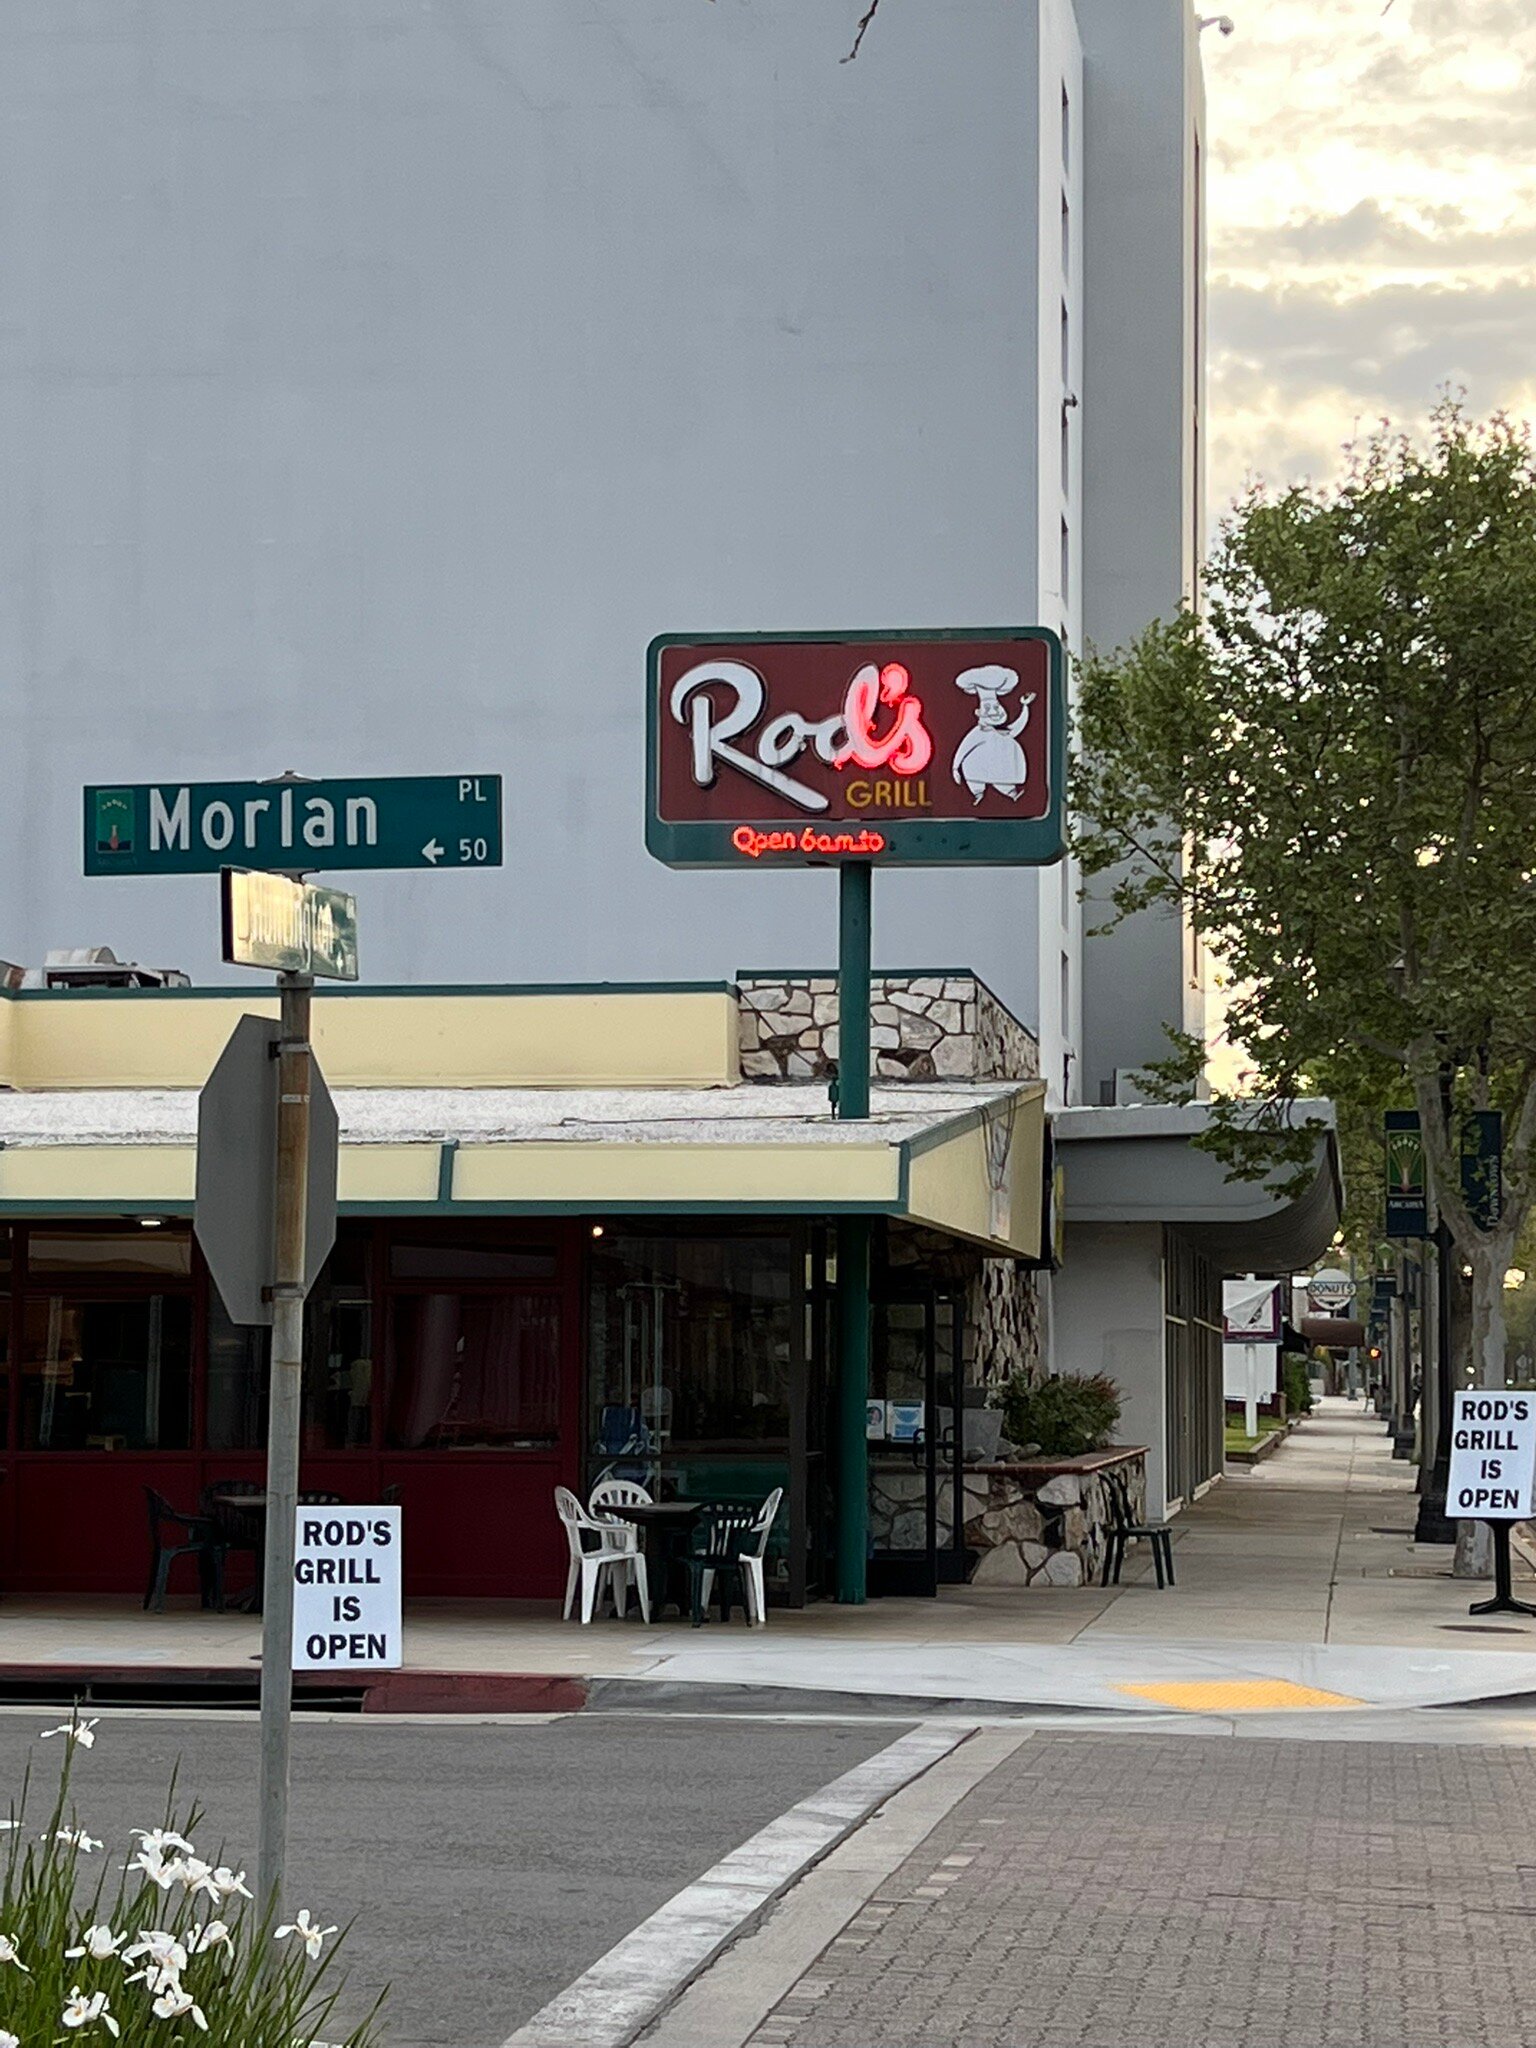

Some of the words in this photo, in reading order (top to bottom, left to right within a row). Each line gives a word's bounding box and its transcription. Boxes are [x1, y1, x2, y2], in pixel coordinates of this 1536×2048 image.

[671, 659, 933, 812] Rod's
[459, 779, 488, 802] PL
[846, 780, 932, 808] GRILL
[149, 787, 378, 851] Morlan
[459, 838, 488, 861] 50
[733, 825, 797, 857] Open
[1308, 1282, 1355, 1295] DONUTS
[1461, 1400, 1529, 1420] ROD'S
[1454, 1430, 1519, 1450] GRILL
[1480, 1459, 1502, 1480] IS
[1458, 1488, 1519, 1509] OPEN
[303, 1520, 392, 1546] ROD'S
[294, 1558, 381, 1584] GRILL
[333, 1596, 361, 1622] IS
[306, 1634, 387, 1660] OPEN
